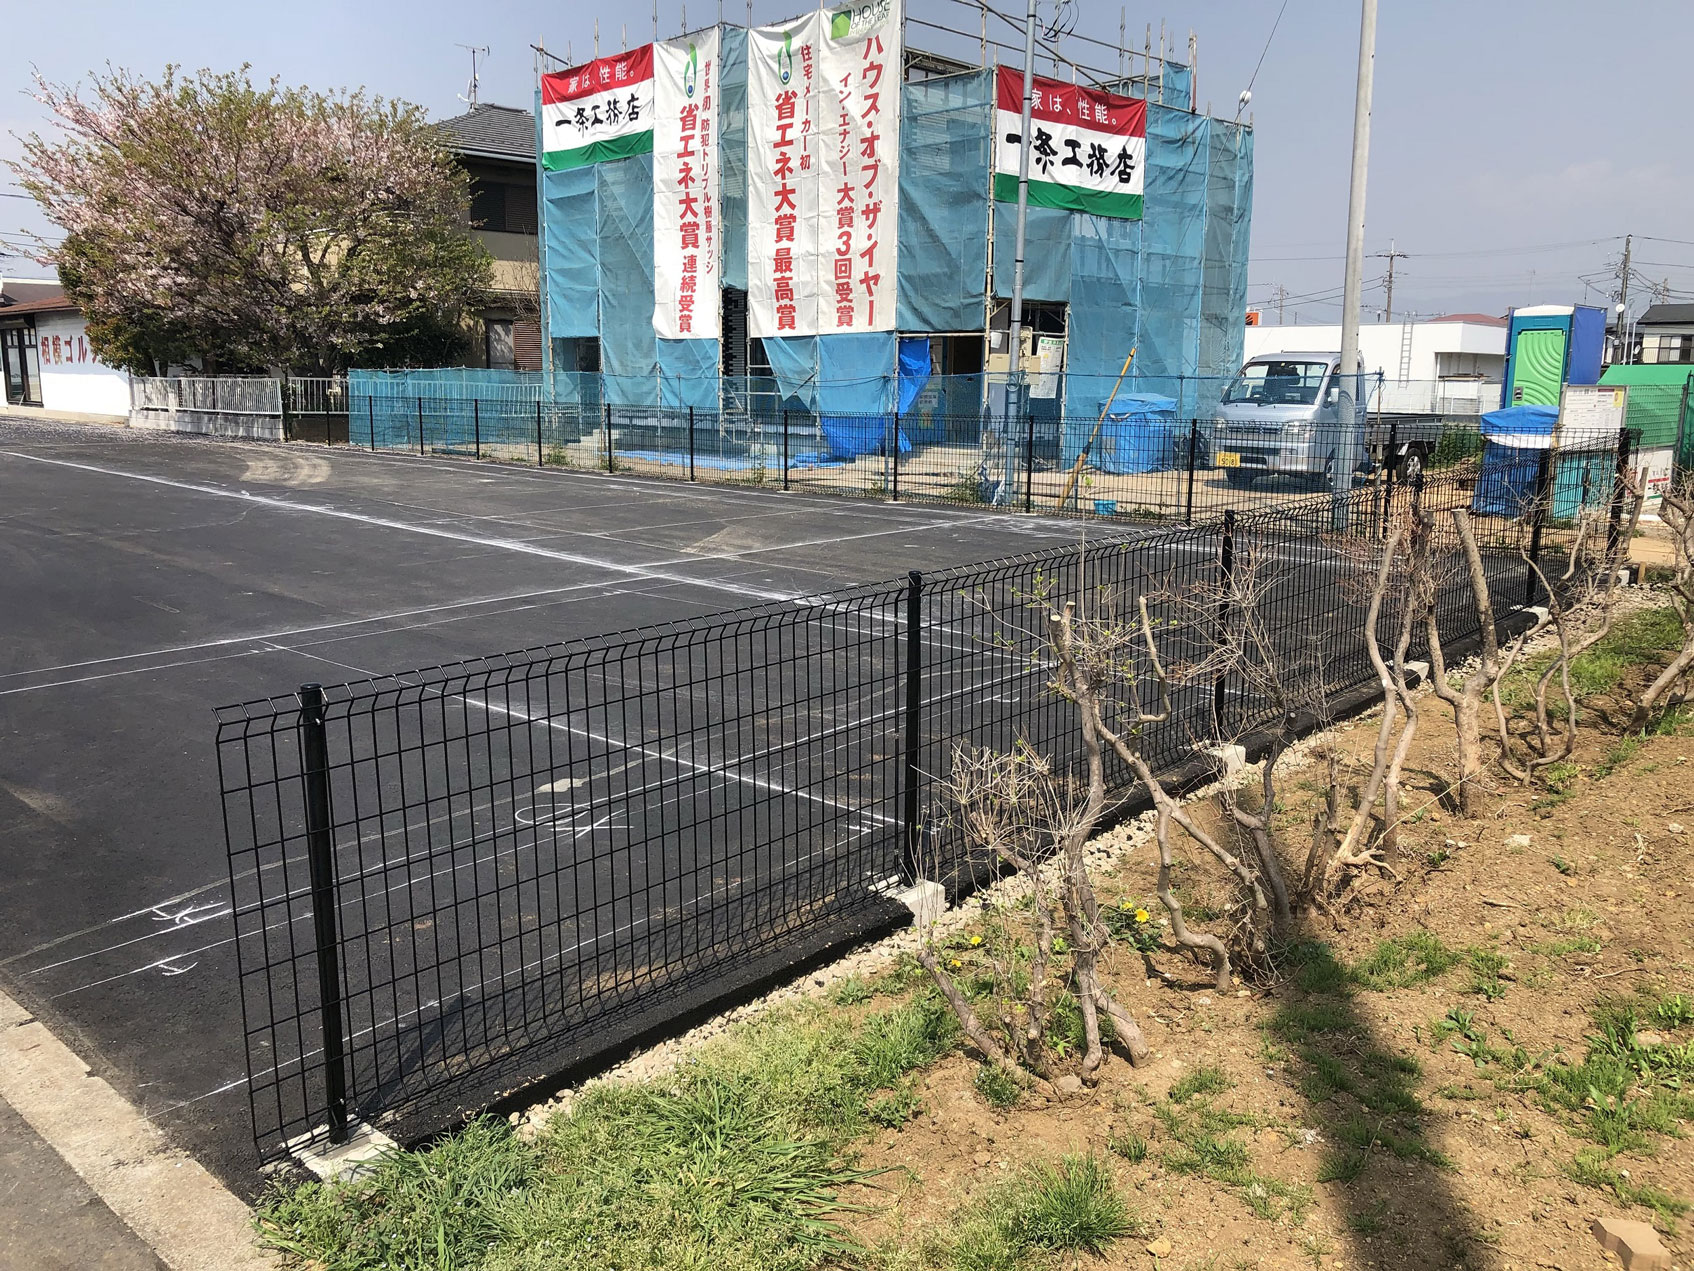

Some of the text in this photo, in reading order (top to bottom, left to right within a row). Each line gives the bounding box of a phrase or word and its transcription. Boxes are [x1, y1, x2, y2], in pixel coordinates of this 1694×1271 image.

[852, 0, 890, 23] HOUSE
[555, 93, 641, 138] 一条工務店
[800, 44, 813, 170] 住宅メーカー初
[859, 36, 884, 327] ハウス・オブ・ザ・イヤー
[1005, 127, 1136, 184] 一条工務店
[772, 90, 798, 331] 省エネ大賞最高賞
[41, 335, 98, 365] 相模ゴル
